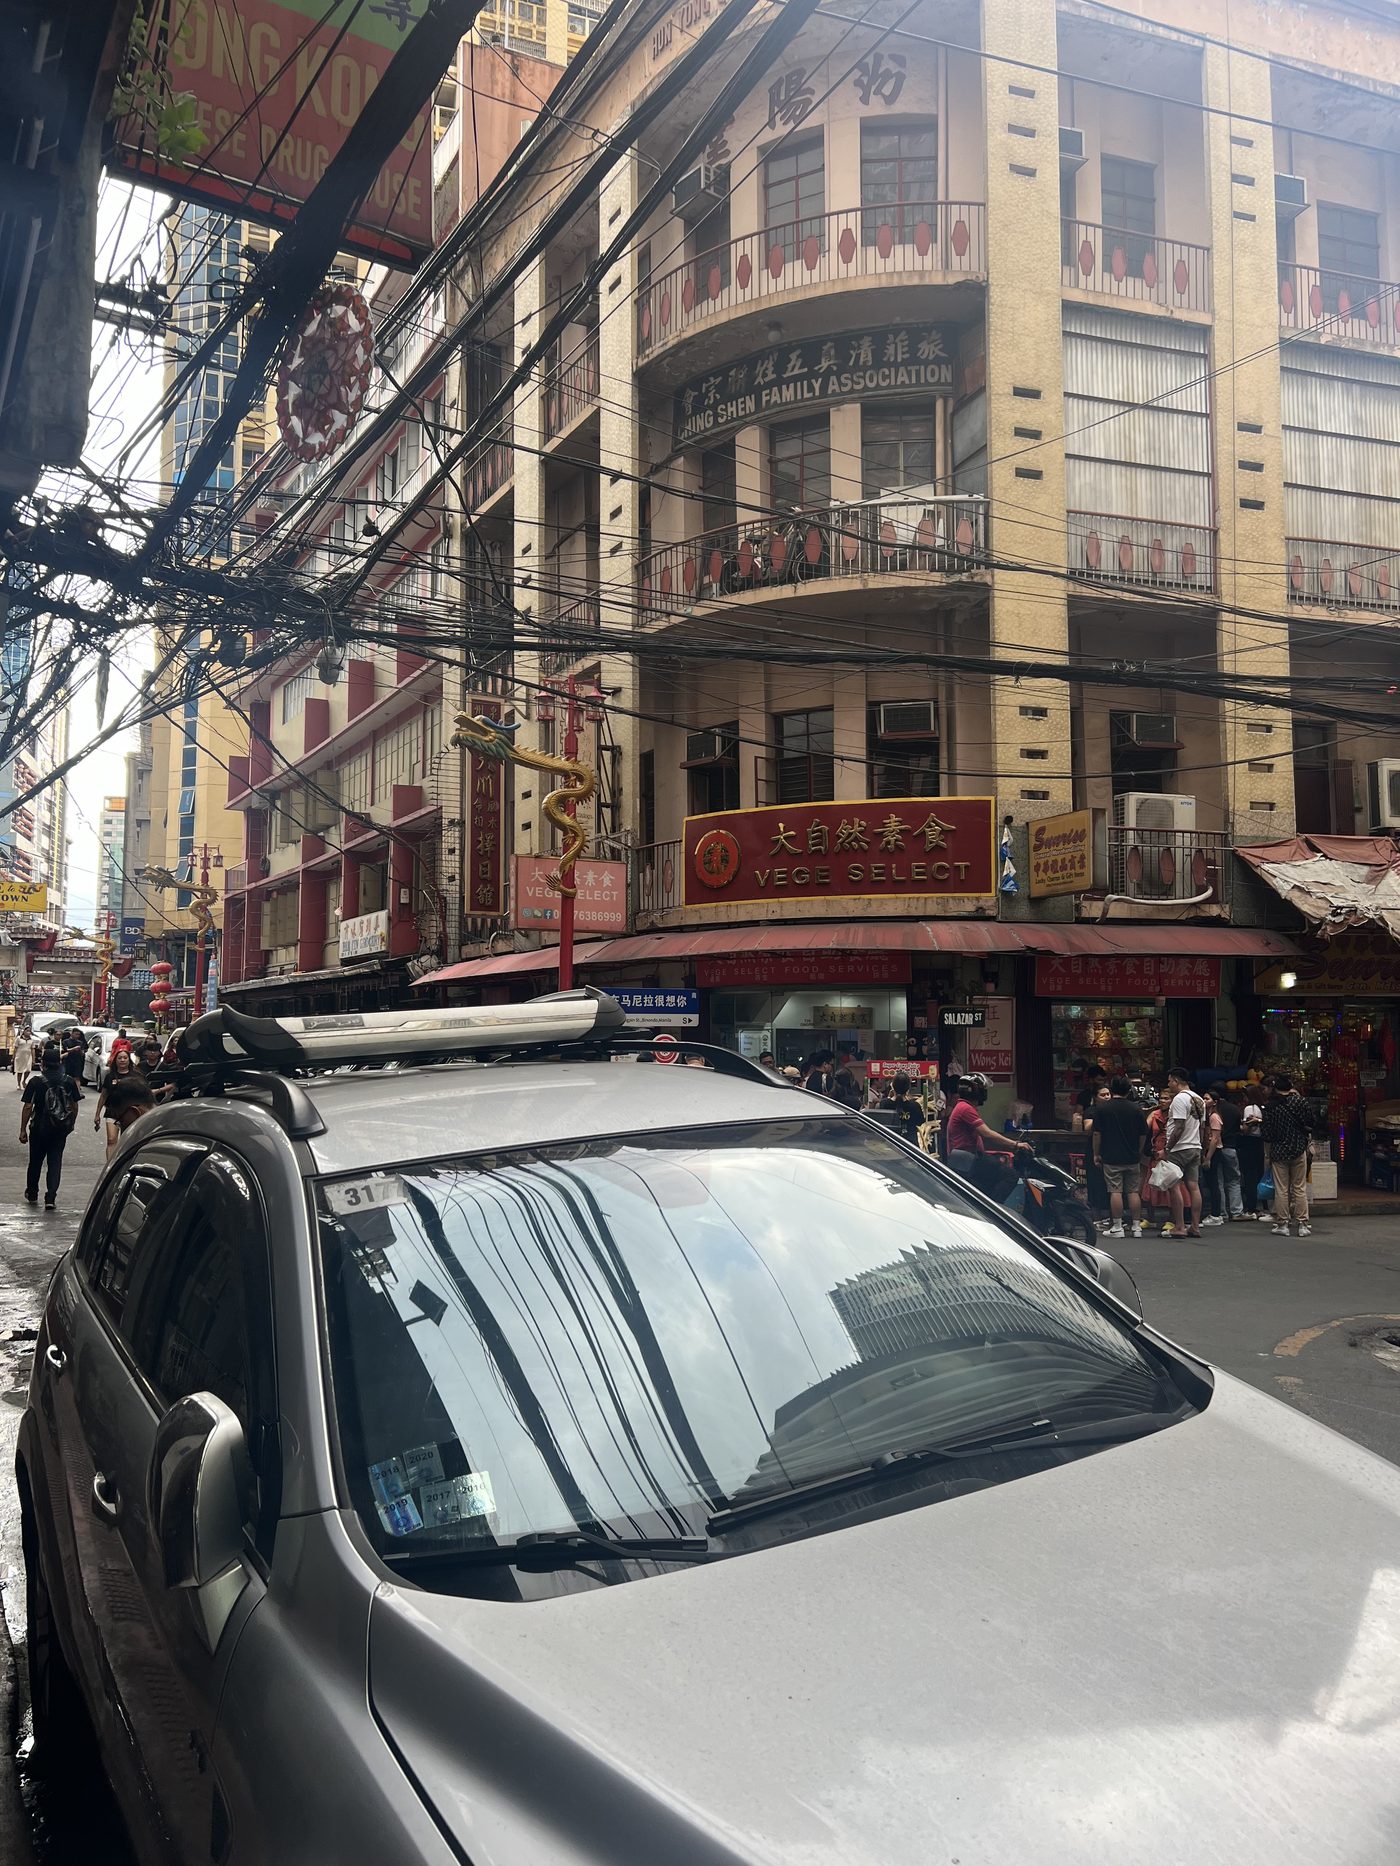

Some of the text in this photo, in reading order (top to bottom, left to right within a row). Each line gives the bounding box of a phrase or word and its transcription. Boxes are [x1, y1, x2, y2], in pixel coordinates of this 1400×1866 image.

[172, 0, 425, 154] ONG KO
[380, 166, 421, 221] USE
[717, 394, 756, 423] SHEN
[761, 374, 822, 409] FAMILY
[826, 364, 953, 395] ASSOCIATION
[769, 812, 957, 857] 大自然素食
[1033, 825, 1087, 852] Sunrise
[754, 860, 971, 888] VEGE SELECT
[8, 884, 15, 892] to
[577, 889, 620, 901] ELECT
[553, 909, 622, 922] 076386999
[125, 926, 142, 935] BD
[733, 966, 776, 975] SELECT
[784, 965, 819, 974] FOOD
[829, 964, 898, 973] SERVICES
[1078, 977, 1121, 985] SELECT
[1127, 978, 1158, 986] FOOD
[1164, 979, 1217, 987] SERVICES
[944, 1012, 983, 1025] SALAZAR ST
[971, 1052, 1012, 1070] Wong Kei
[409, 1451, 434, 1464] 2020
[374, 1464, 400, 1480] 2018
[426, 1490, 451, 1502] 2017
[383, 1498, 408, 1514] 2019
